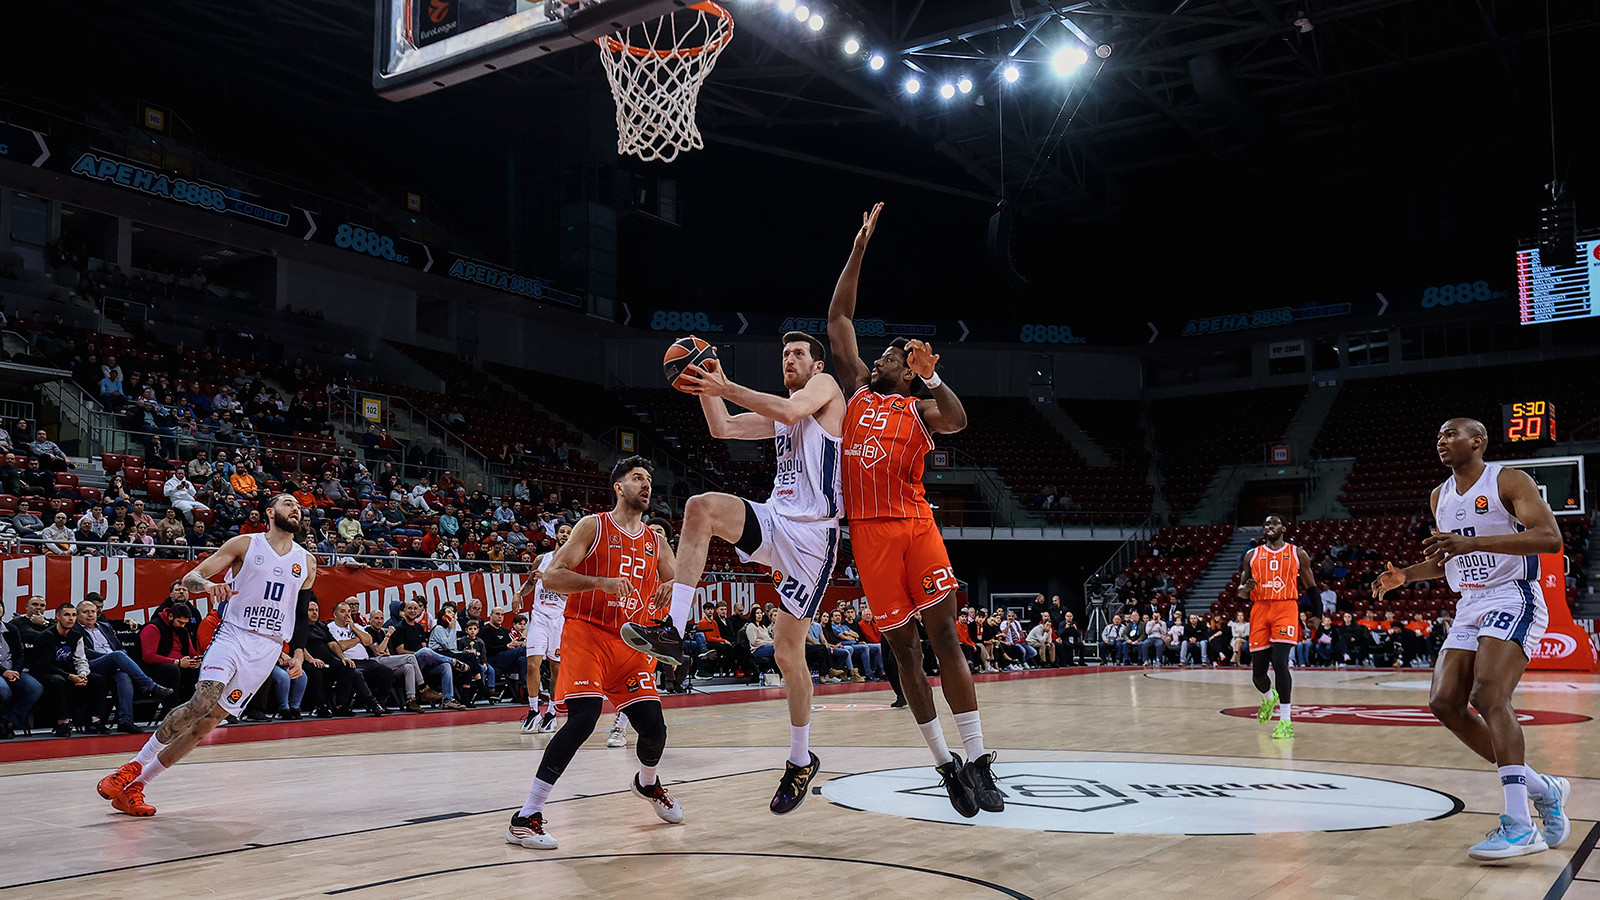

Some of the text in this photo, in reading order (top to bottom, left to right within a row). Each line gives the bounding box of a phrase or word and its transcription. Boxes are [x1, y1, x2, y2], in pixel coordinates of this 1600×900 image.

[76, 154, 170, 196] АРЕНА
[172, 179, 226, 210] 8888
[450, 260, 509, 290] АРЕНА
[509, 276, 542, 298] 8888
[781, 320, 828, 333] АРЕ
[1183, 315, 1250, 335] АРЕНА
[1250, 308, 1294, 327] 8888
[367, 406, 377, 414] 102
[1513, 401, 1545, 417] 5:30
[859, 408, 890, 430] 25
[1508, 417, 1542, 438] 20
[777, 434, 792, 457] 24
[862, 445, 879, 459] IBI
[619, 555, 646, 579] 22
[1269, 560, 1279, 571] 0
[264, 580, 285, 602] 10
[539, 593, 559, 602] EFES
[781, 575, 809, 608] 24
[243, 606, 286, 622] ANADO
[249, 616, 282, 631] EFES
[1287, 625, 1295, 637] 0
